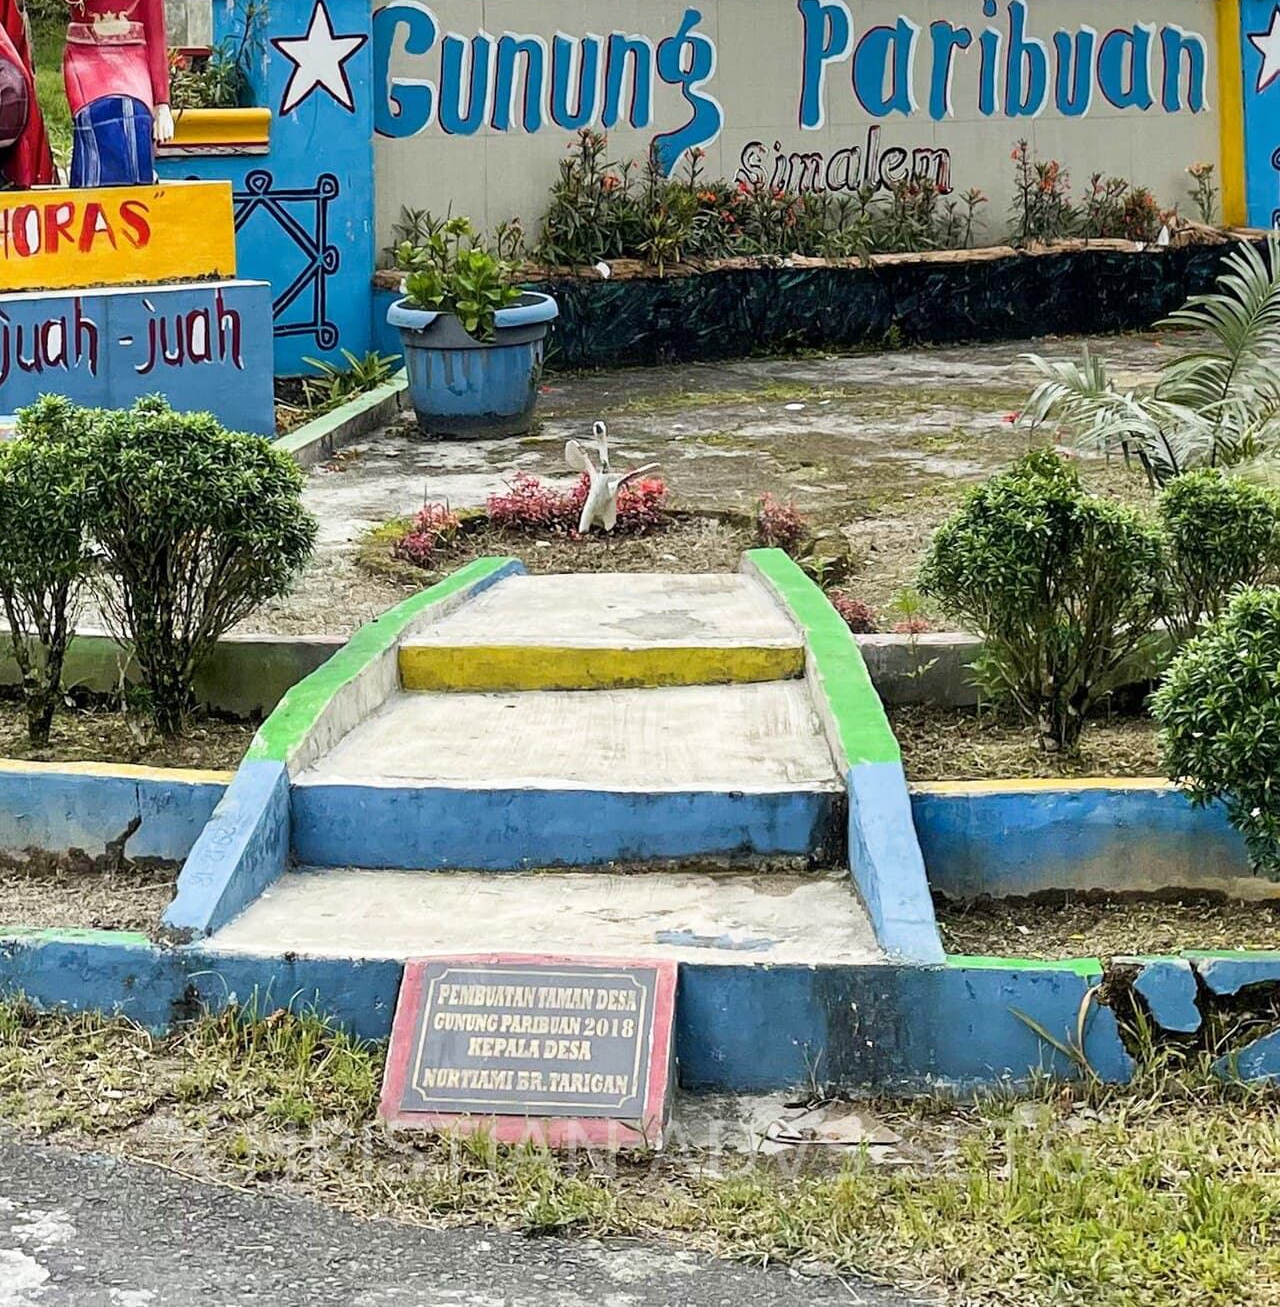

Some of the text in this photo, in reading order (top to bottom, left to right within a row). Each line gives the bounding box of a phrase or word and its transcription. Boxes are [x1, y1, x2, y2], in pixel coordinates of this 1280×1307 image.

[372, 0, 724, 178] Gunung
[437, 984, 637, 1012] PEMBUATAN TAMAN DESA
[434, 1012, 635, 1038] GUNUNG PARIBUAN 2018
[468, 1037, 591, 1061] KEPALA DESA
[422, 1068, 514, 1090] NURTIAMI
